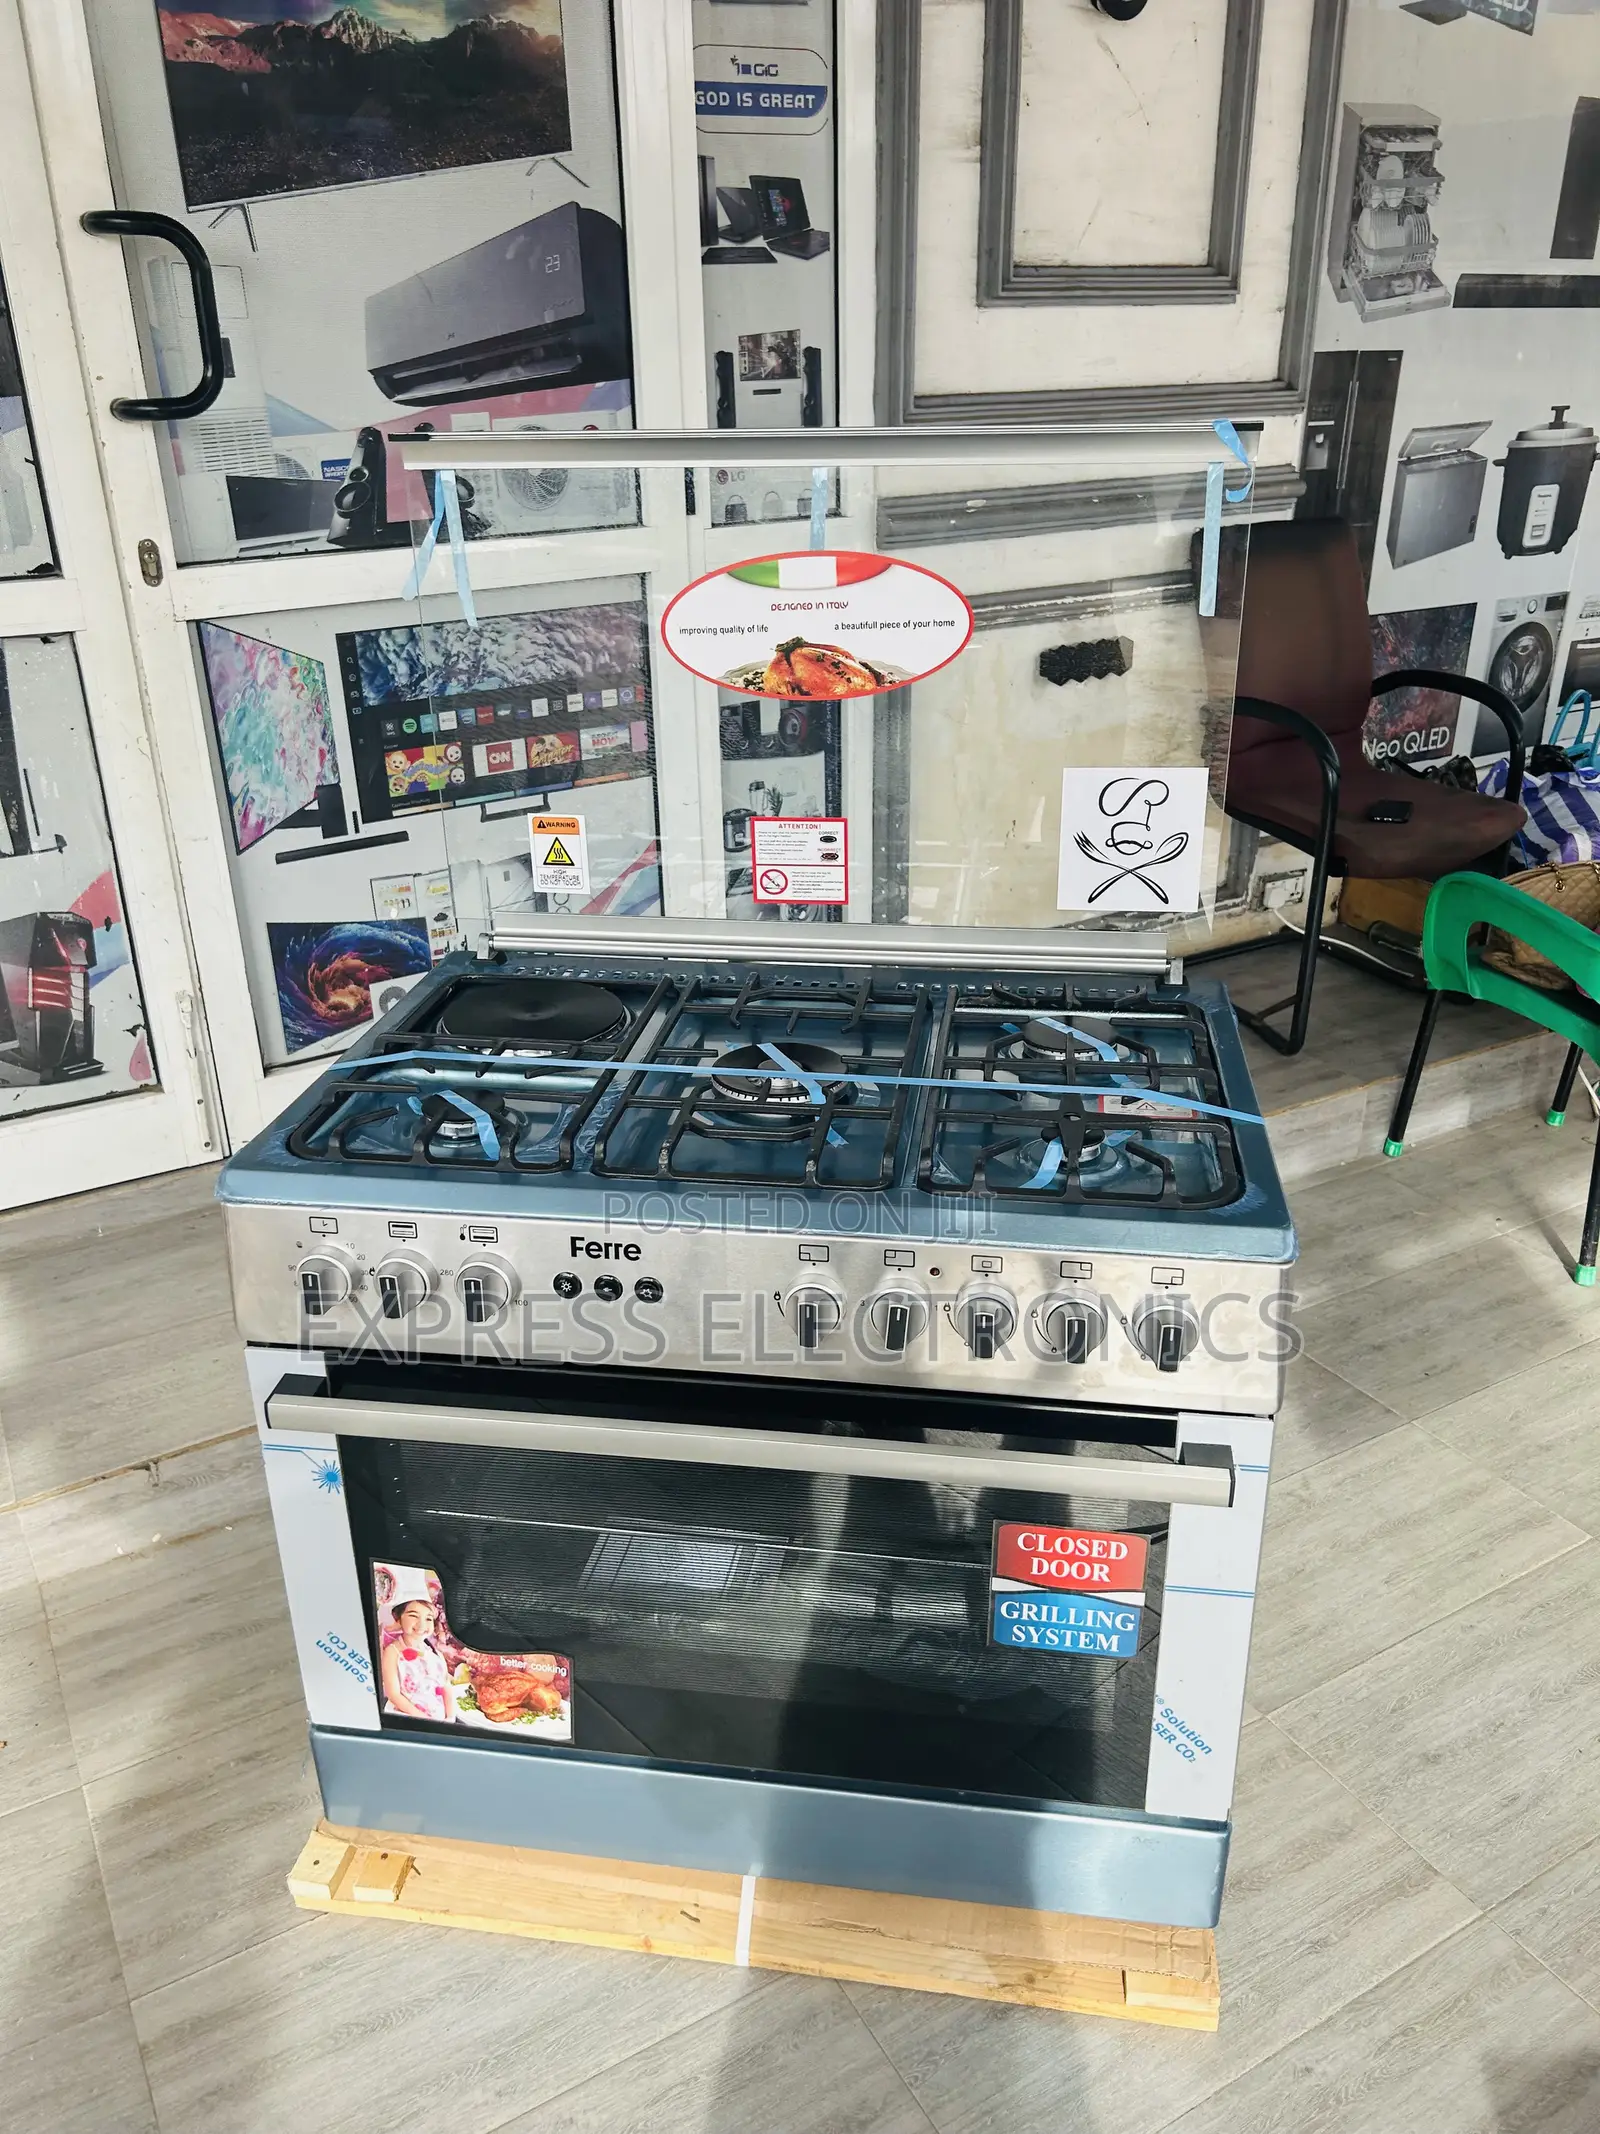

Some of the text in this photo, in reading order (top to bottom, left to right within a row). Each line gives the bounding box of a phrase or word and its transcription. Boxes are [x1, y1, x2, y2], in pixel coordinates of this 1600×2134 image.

[695, 91, 816, 108] GOD IS GREAT
[545, 254, 560, 273] 23
[730, 471, 745, 482] LG
[679, 624, 769, 636] improving quality of life
[841, 621, 878, 630] beautifull
[879, 620, 901, 630] piece
[902, 620, 911, 629] of
[912, 620, 931, 630] your
[932, 619, 956, 627] home
[1362, 726, 1450, 760] Neo QLED
[570, 1236, 642, 1261] Ferre
[1017, 1532, 1129, 1560] CLOSED
[1030, 1556, 1111, 1583] DOOR
[1000, 1601, 1136, 1631] GRILLING
[1012, 1624, 1121, 1653] SYSTEM
[316, 1639, 368, 1683] Solution
[500, 1655, 567, 1677] better cooking
[1152, 1717, 1177, 1744] SER
[1160, 1707, 1213, 1755] Solution
